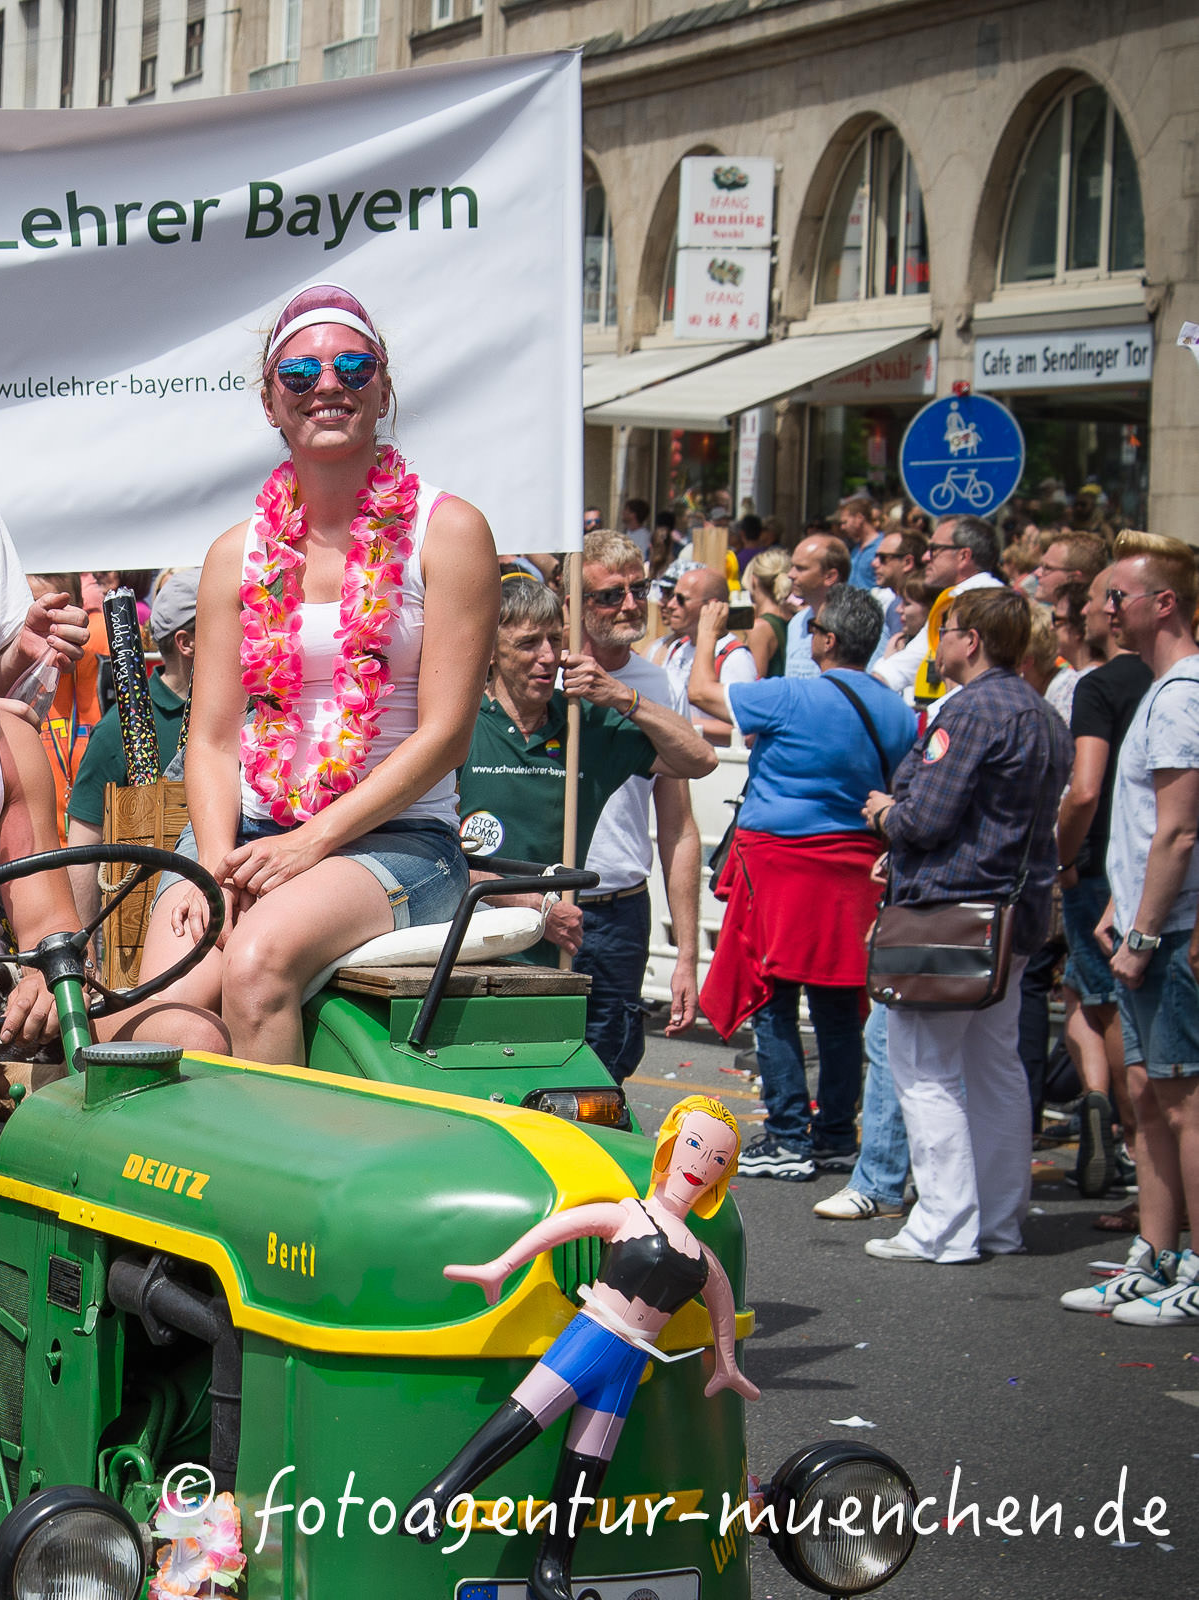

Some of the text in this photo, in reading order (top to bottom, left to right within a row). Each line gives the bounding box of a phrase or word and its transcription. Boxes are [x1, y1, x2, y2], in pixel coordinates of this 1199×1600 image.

[244, 181, 479, 250] Bayern
[693, 211, 766, 228] Running
[982, 340, 1149, 377] Cafe am Sendlinger Tor
[110, 611, 135, 681] Party Popper
[465, 824, 500, 840] HOMO
[472, 816, 499, 829] STOP
[121, 1153, 211, 1200] DEUTZ
[267, 1231, 316, 1277] Bertl
